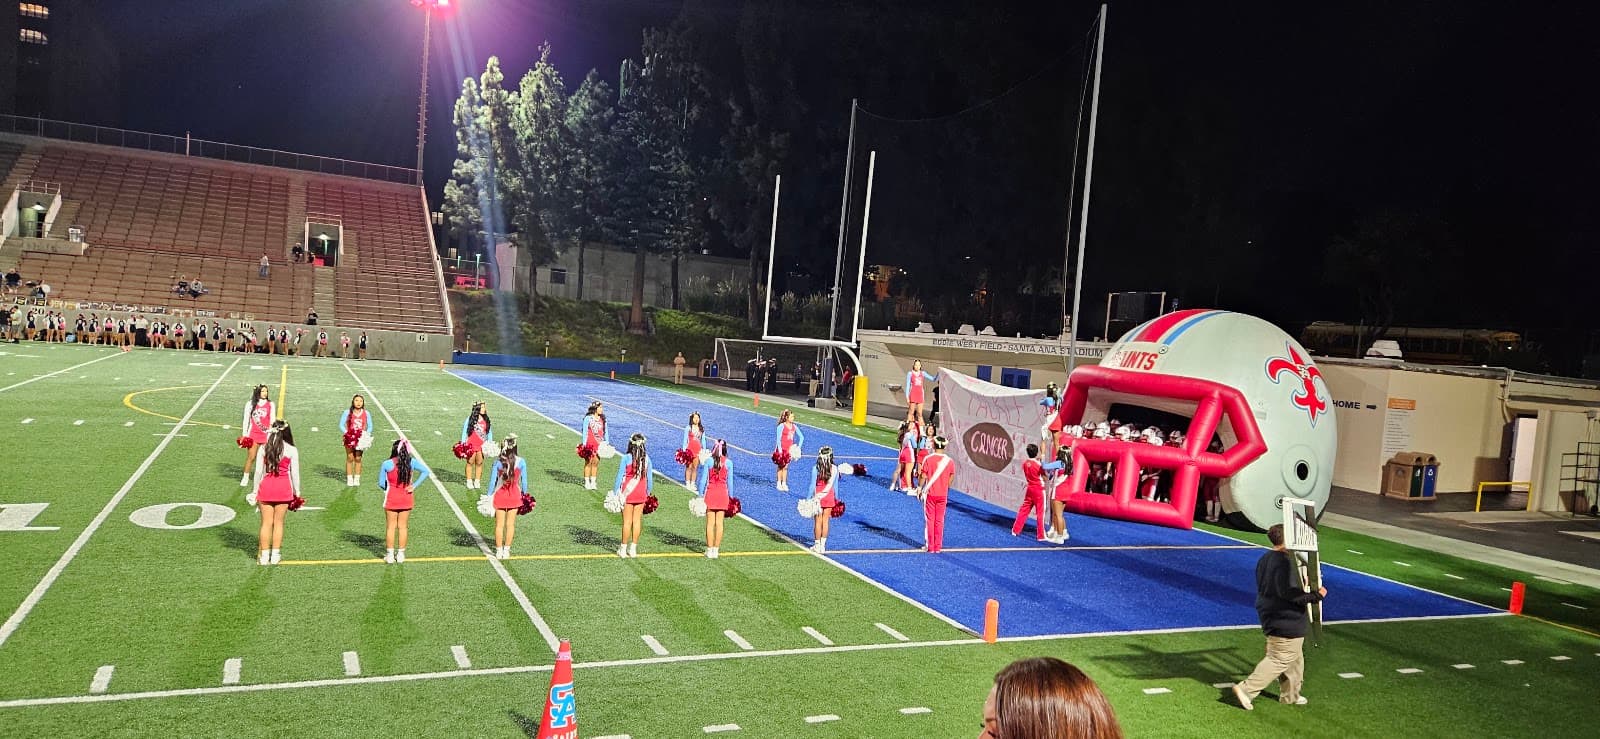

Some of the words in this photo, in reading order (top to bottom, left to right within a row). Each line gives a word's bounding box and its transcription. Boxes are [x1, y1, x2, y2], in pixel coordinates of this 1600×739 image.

[957, 339, 978, 349] WEST
[979, 341, 1002, 350] FIELD
[1008, 344, 1035, 354] SANTA
[1038, 345, 1057, 355] ANA
[1332, 400, 1360, 410] HOME
[970, 431, 1008, 460] CANCER
